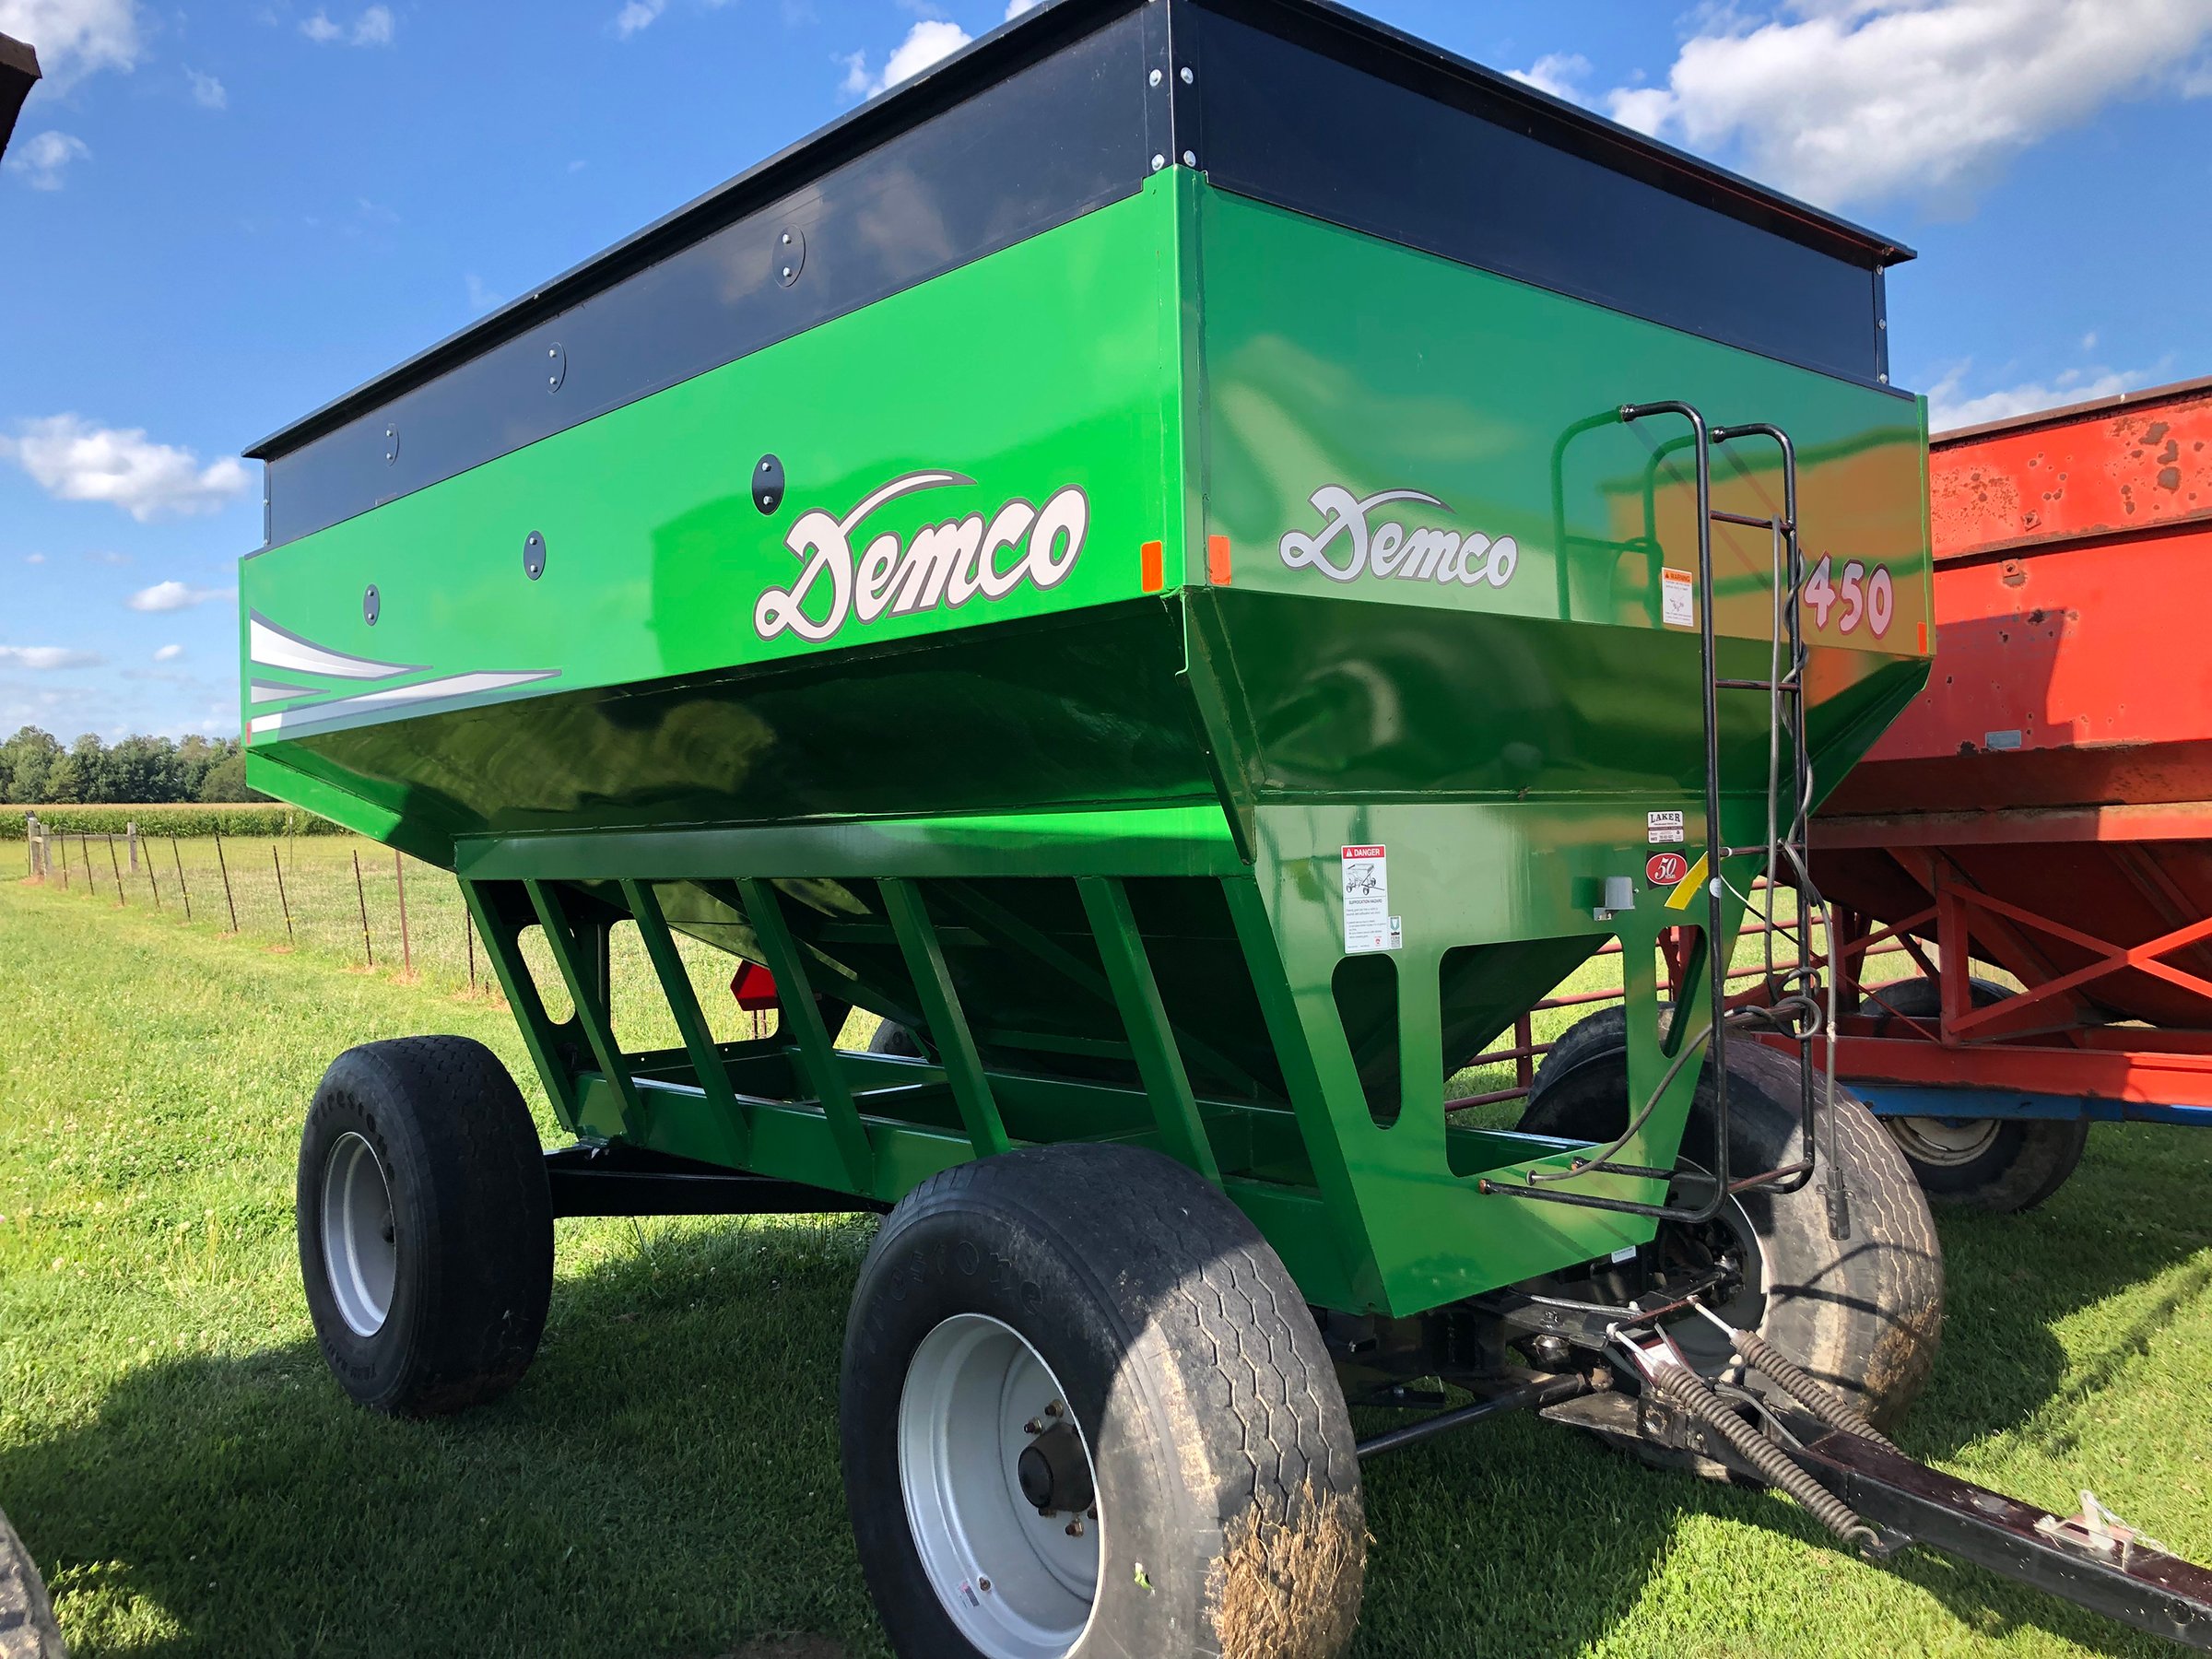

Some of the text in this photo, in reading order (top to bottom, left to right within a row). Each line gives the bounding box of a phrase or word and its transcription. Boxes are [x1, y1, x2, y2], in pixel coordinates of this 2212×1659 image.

[753, 469, 1089, 643] Demco
[1278, 483, 1519, 589] Demco
[1670, 572, 1690, 582] WARNING
[1803, 550, 1894, 640] 450
[1650, 813, 1680, 823] LAKER
[1354, 848, 1381, 857] DANGER
